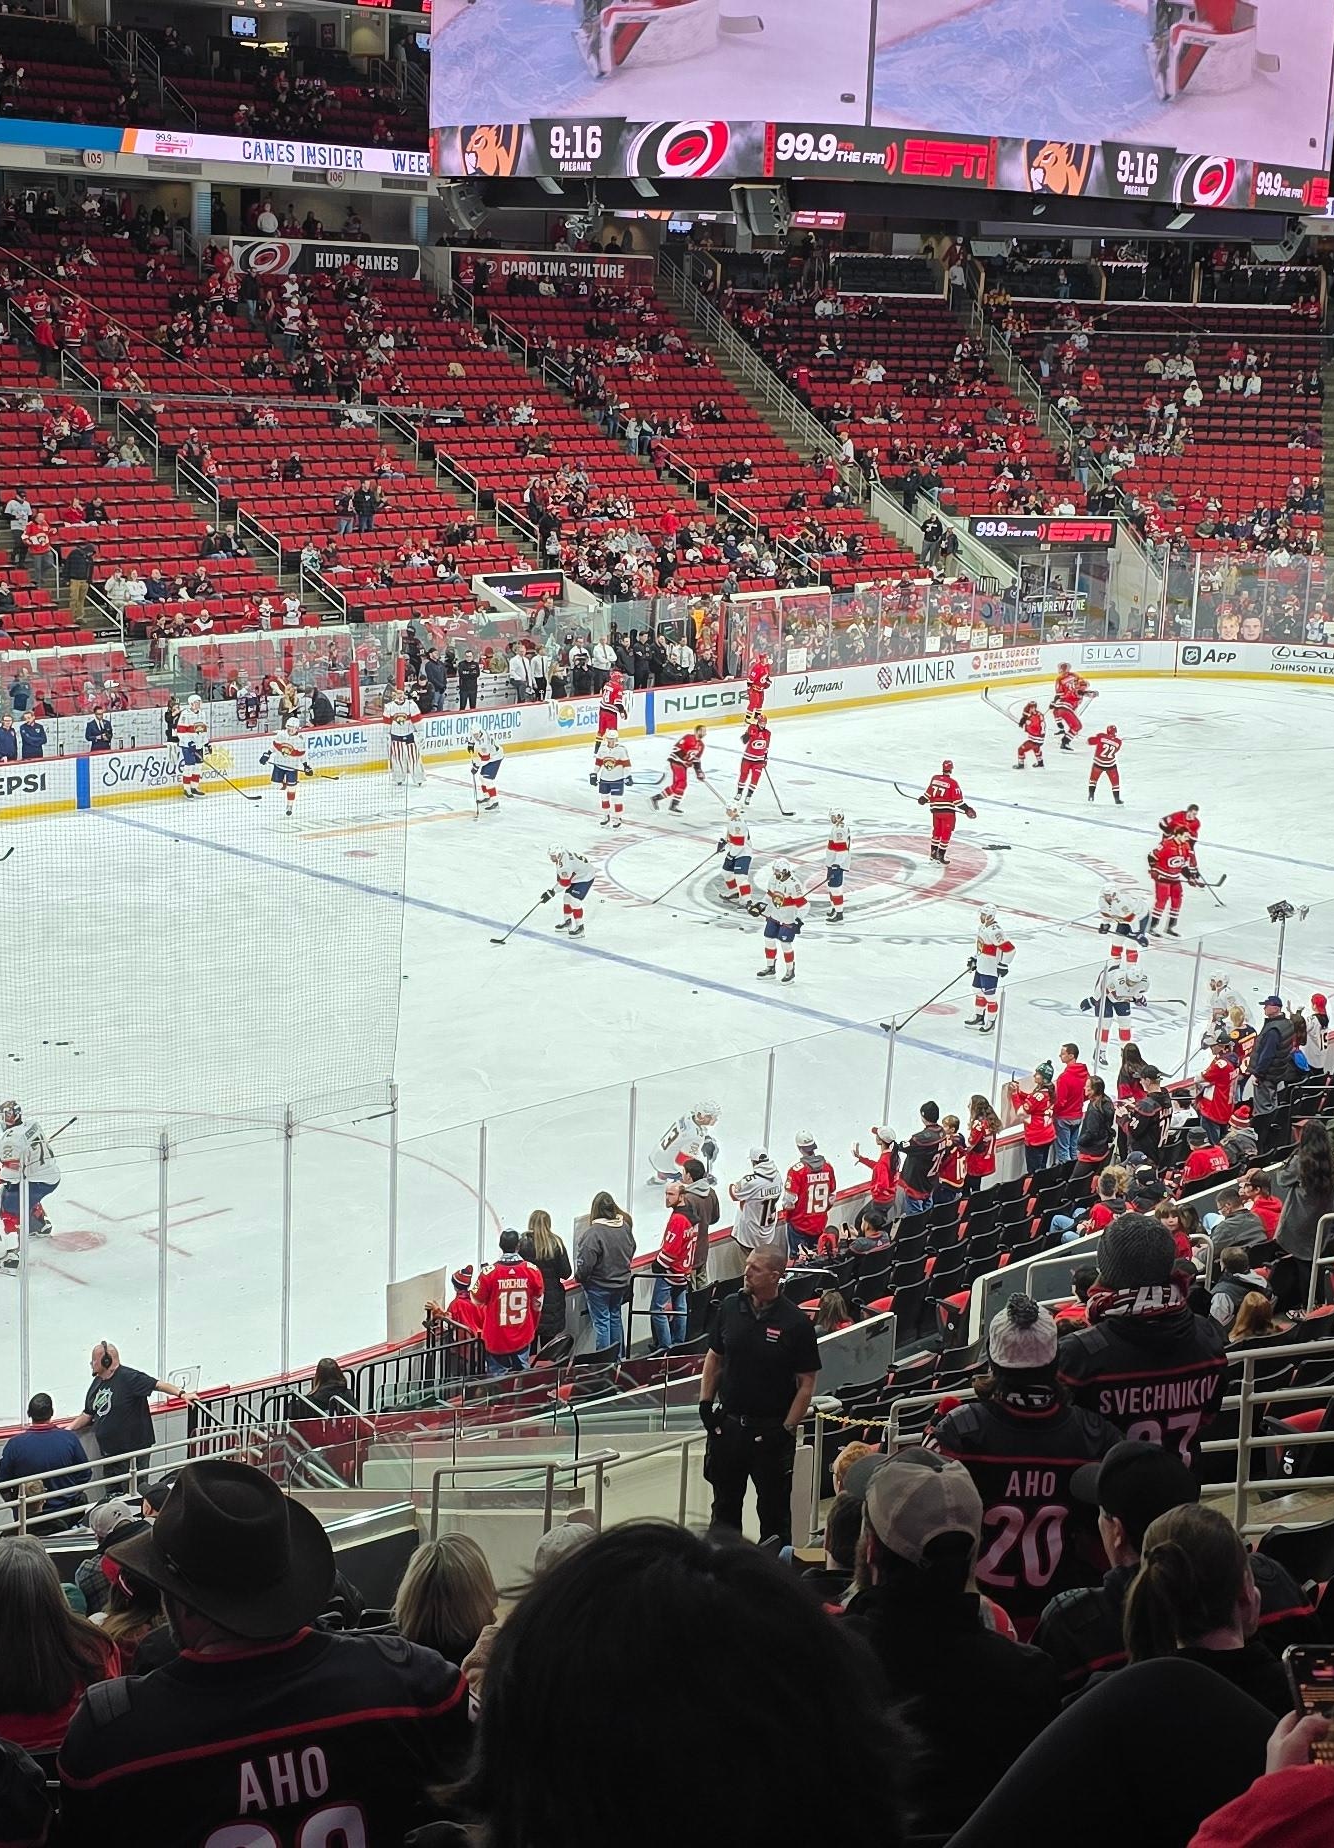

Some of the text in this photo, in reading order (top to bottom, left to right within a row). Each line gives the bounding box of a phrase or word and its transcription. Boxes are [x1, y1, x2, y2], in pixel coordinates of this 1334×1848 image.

[550, 126, 602, 159] 9:16
[776, 133, 886, 165] 99.9 THE FAN
[86, 152, 103, 165] 105
[242, 140, 364, 170] CANES INSIDER
[902, 138, 989, 181] ESPN
[560, 161, 591, 172] PREGAME
[1117, 151, 1159, 185] 9:16
[329, 171, 344, 182] 106
[1256, 171, 1282, 196] 99.9
[315, 252, 399, 272] HURRCANES
[502, 260, 567, 276] CAROLINA
[976, 522, 1008, 537] 99.9
[1048, 522, 1112, 541] ESPN
[1044, 601, 1065, 612] BREW
[984, 647, 1041, 661] ORAL SURGERY
[1087, 648, 1136, 660] SILAC
[896, 660, 956, 686] MILNER
[989, 658, 1040, 671] ORTHODONTICS
[1270, 663, 1315, 674] JOHNSON
[793, 676, 843, 702] Wegmans
[426, 720, 454, 739] LEIGH
[308, 731, 367, 750] FANDUEL
[1100, 744, 1116, 760] 22
[147, 776, 169, 786] ICED
[932, 785, 947, 798] 77
[807, 1182, 829, 1215] 19
[498, 1291, 528, 1327] 19
[1004, 1471, 1057, 1498] AHO
[974, 1504, 1069, 1589] 20
[240, 1745, 331, 1815] AHO
